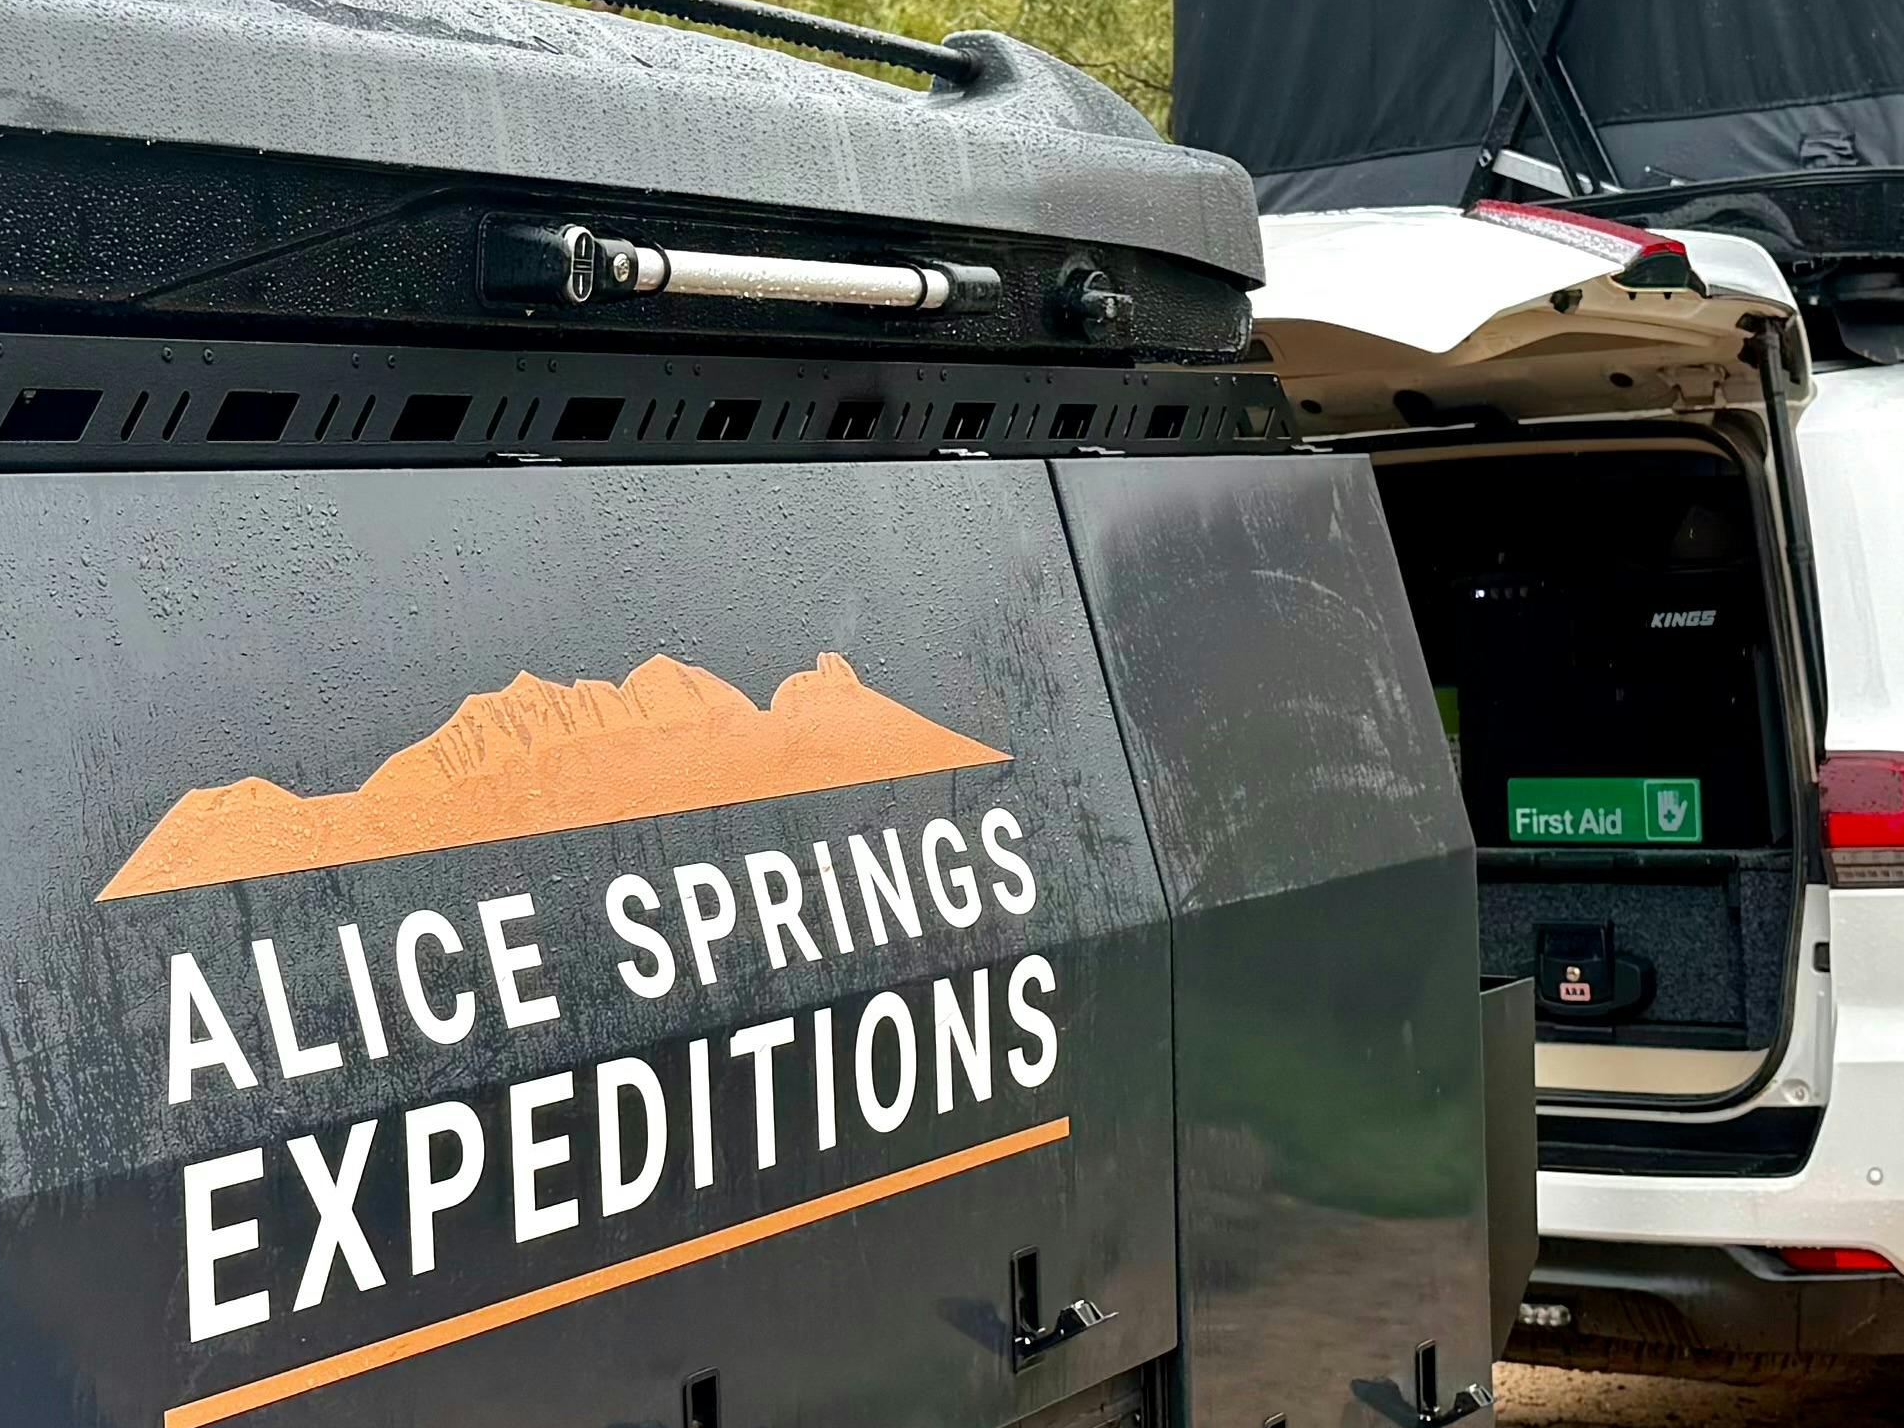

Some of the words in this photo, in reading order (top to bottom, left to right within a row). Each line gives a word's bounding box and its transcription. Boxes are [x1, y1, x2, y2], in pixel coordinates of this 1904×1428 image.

[1650, 610, 1717, 629] KINGS
[1516, 808, 1575, 835] First
[1578, 808, 1623, 835] Aid
[166, 891, 561, 1106] ALICE
[604, 805, 1040, 1000] SPRINGS
[182, 952, 1060, 1344] EXPEDITIONS
